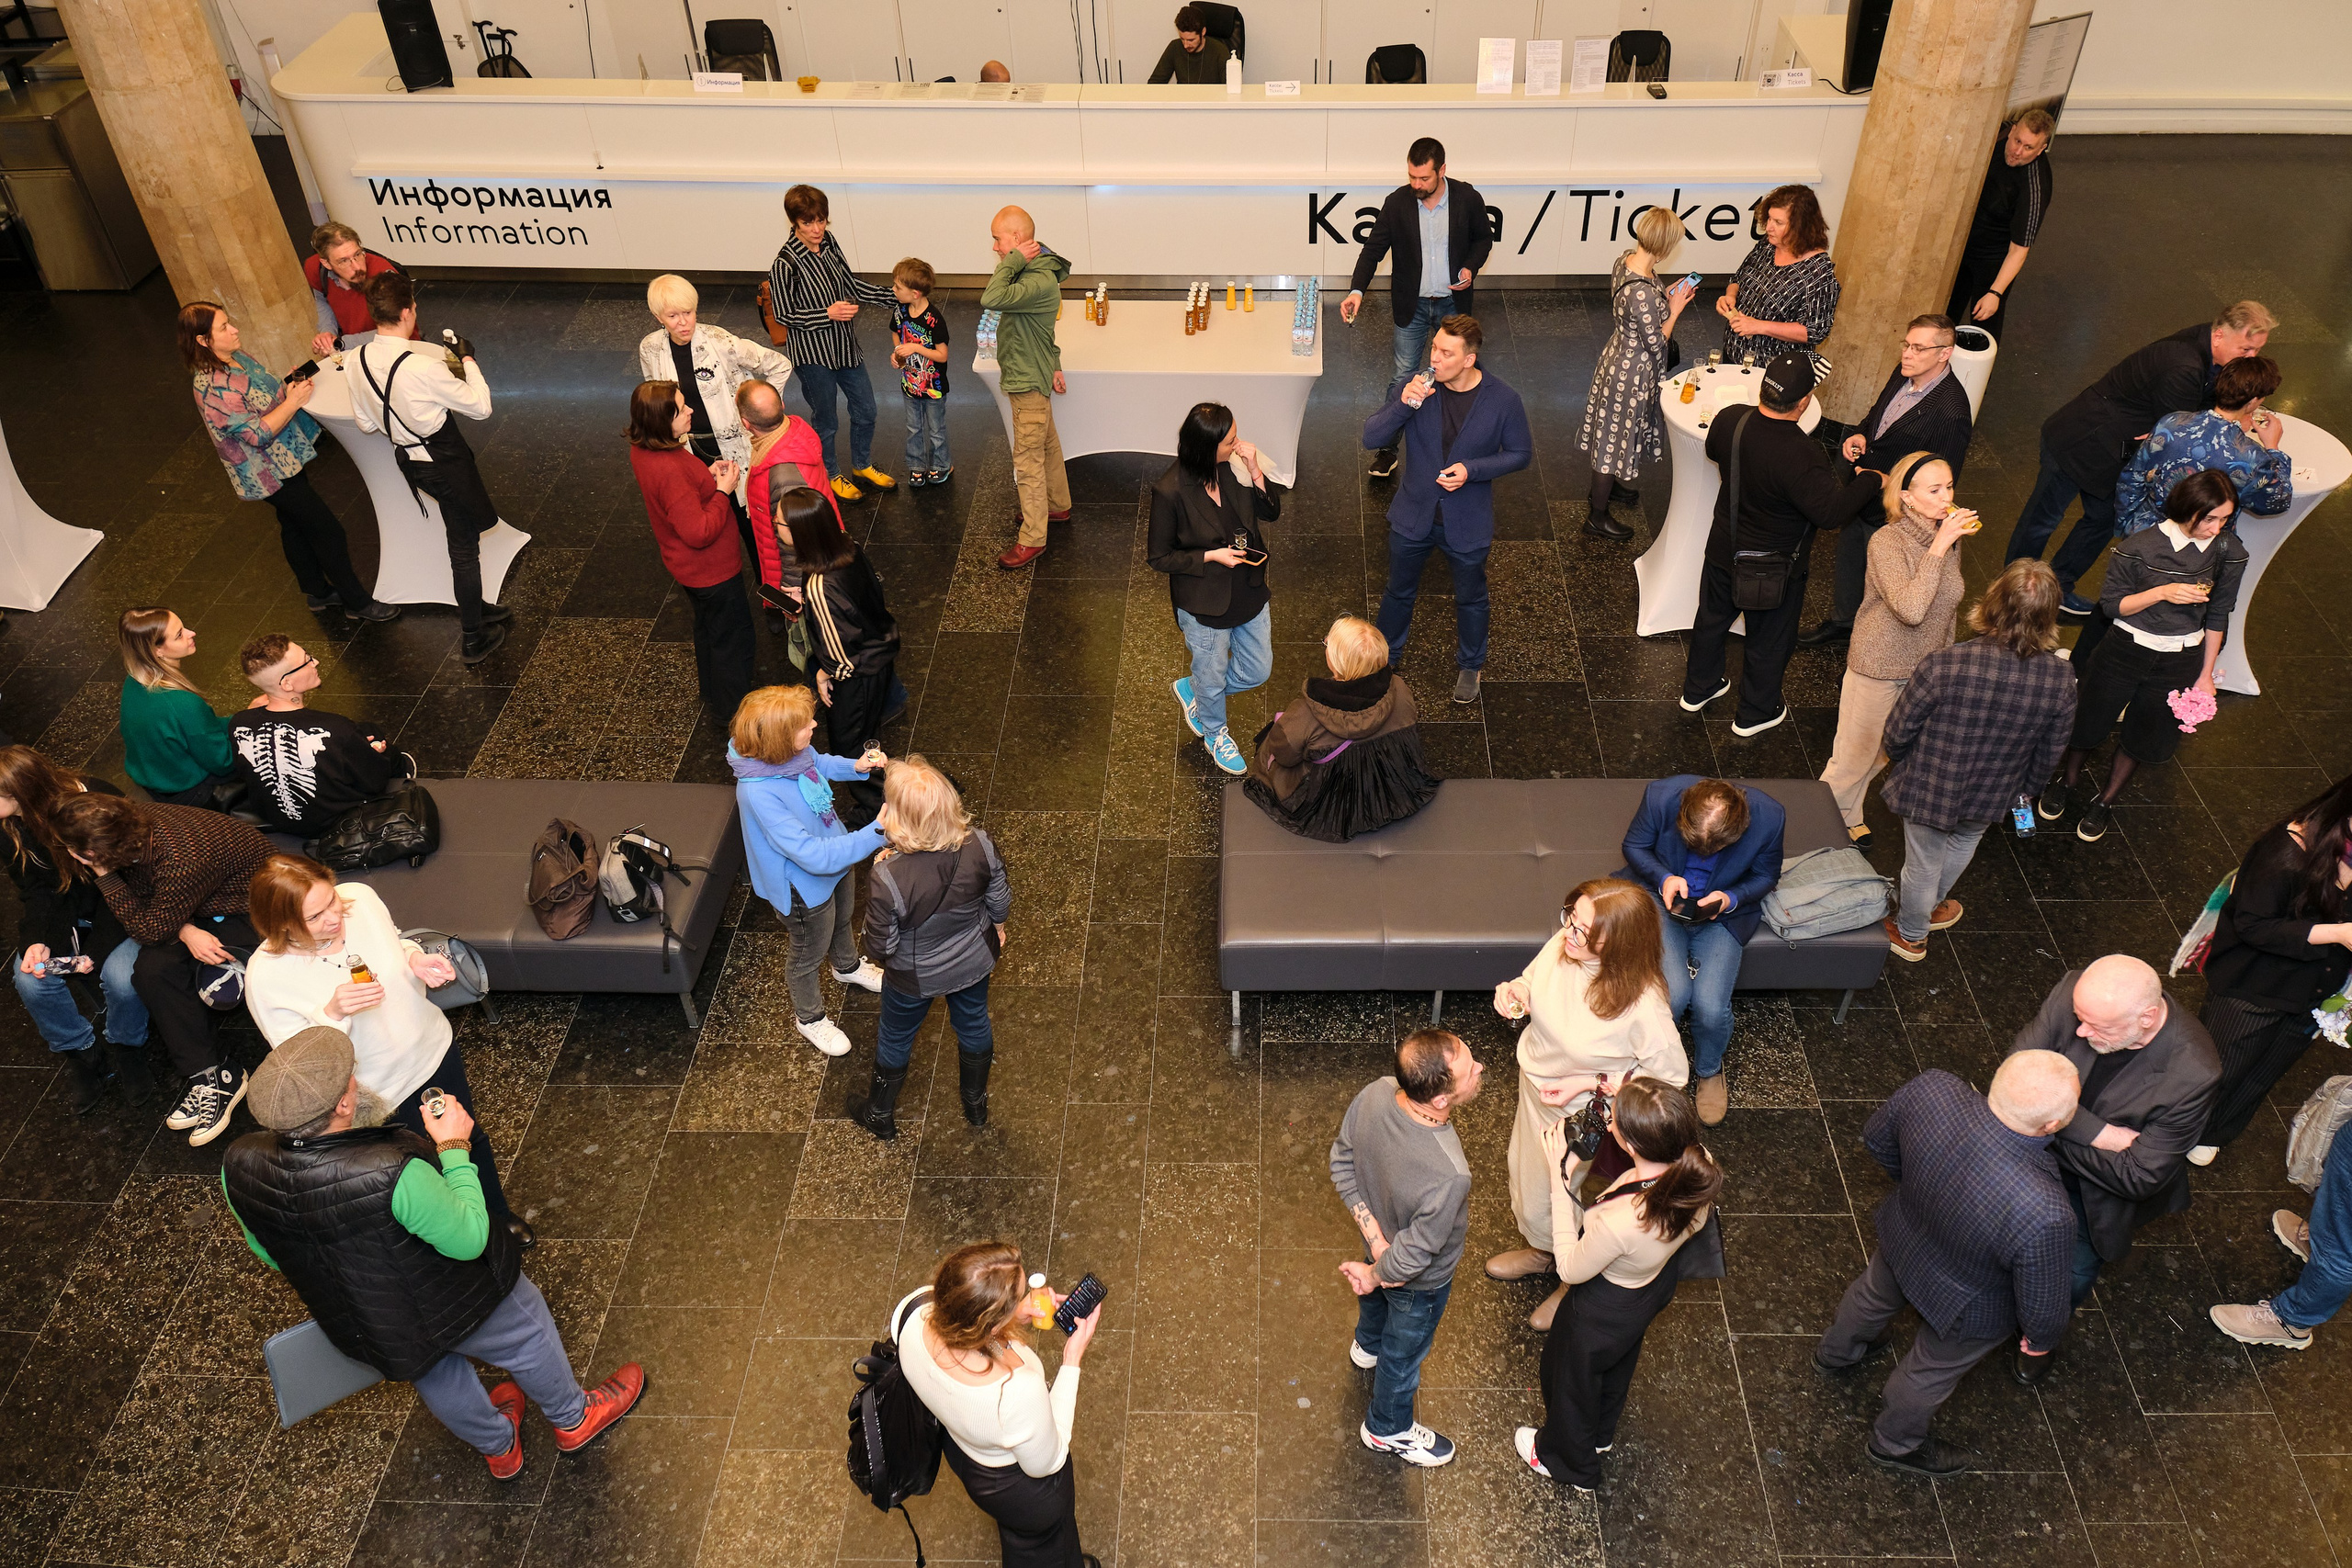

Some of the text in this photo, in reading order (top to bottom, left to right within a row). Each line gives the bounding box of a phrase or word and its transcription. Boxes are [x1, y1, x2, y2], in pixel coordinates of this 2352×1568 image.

[368, 178, 613, 214] Информация
[381, 216, 589, 245] Information
[1308, 192, 1504, 244] Каа
[1569, 188, 1768, 242] Ticket
